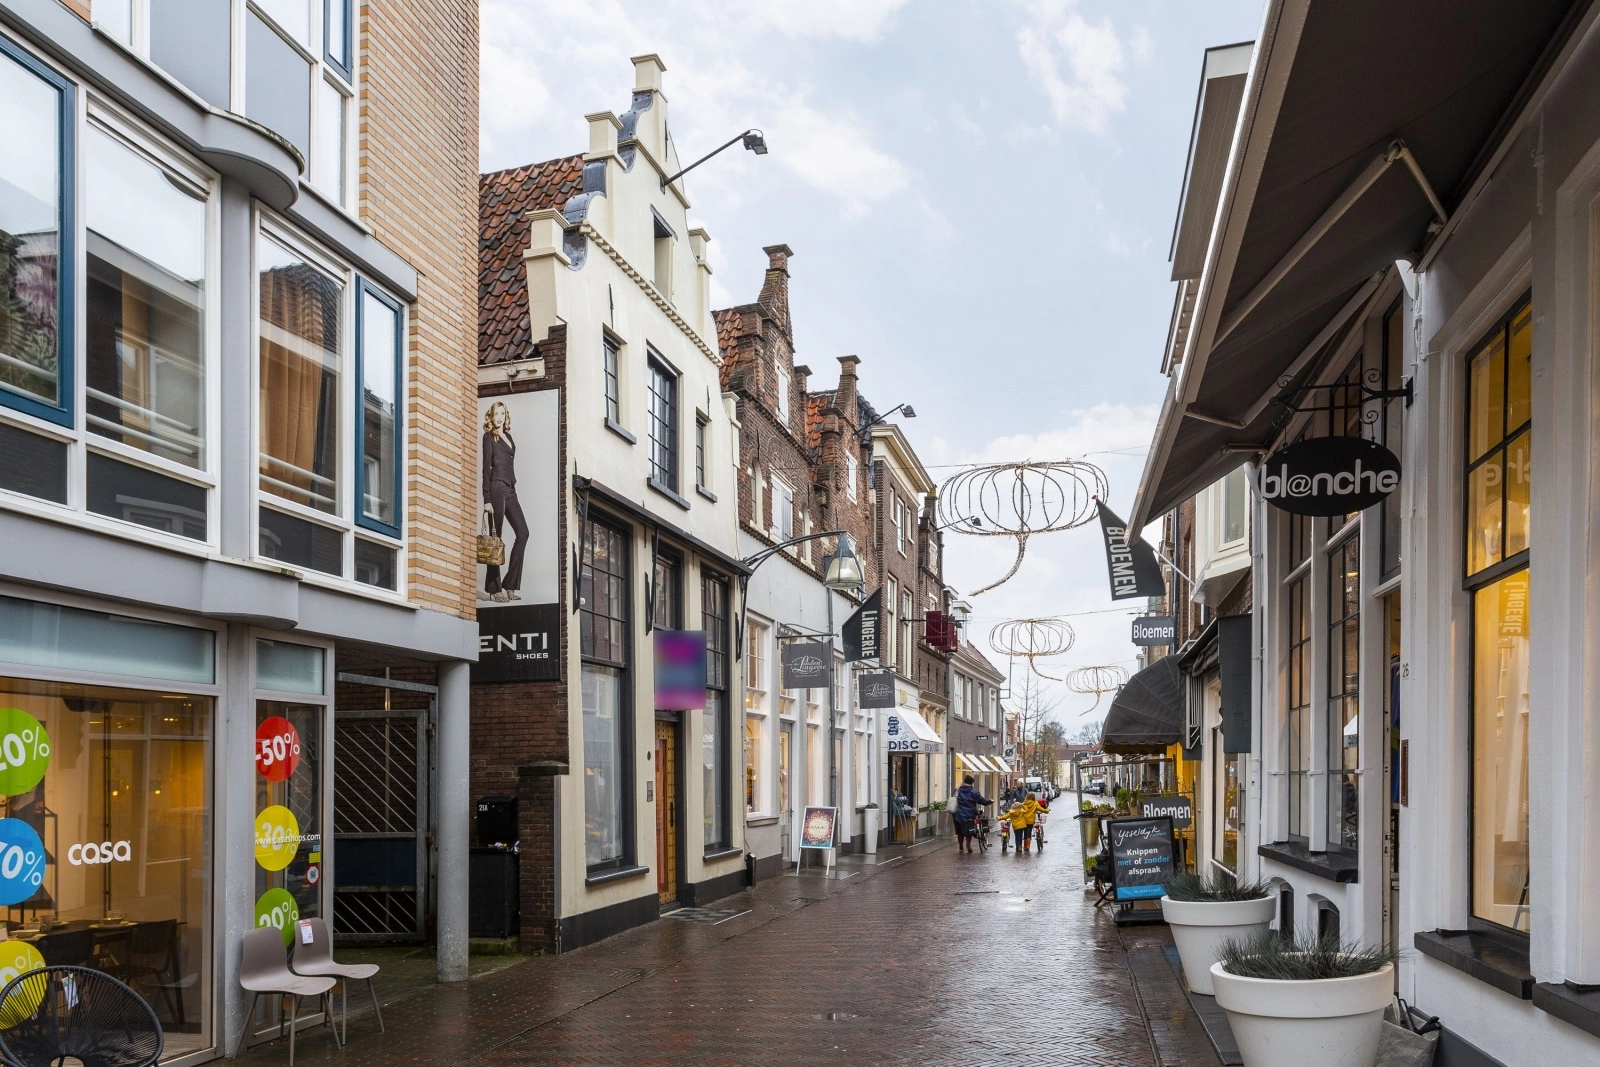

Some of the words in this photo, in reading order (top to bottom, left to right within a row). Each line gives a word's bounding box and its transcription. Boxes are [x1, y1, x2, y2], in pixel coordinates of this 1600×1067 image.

[1261, 458, 1399, 498] bl@nche
[1106, 526, 1138, 596] BLOEMEN
[1133, 623, 1174, 639] Bloemen
[479, 632, 548, 652] ENTI
[516, 652, 549, 660] SHOES
[1402, 662, 1410, 678] 26
[255, 731, 300, 766] -50%
[888, 740, 920, 751] DISC
[478, 804, 489, 812] 21A
[1143, 803, 1191, 819] Bloemen
[68, 840, 131, 866] casa
[1126, 848, 1159, 857] Knippen
[1118, 859, 1133, 867] met
[1134, 857, 1142, 866] of
[1144, 855, 1171, 865] zonder
[1128, 866, 1162, 876] afspraak
